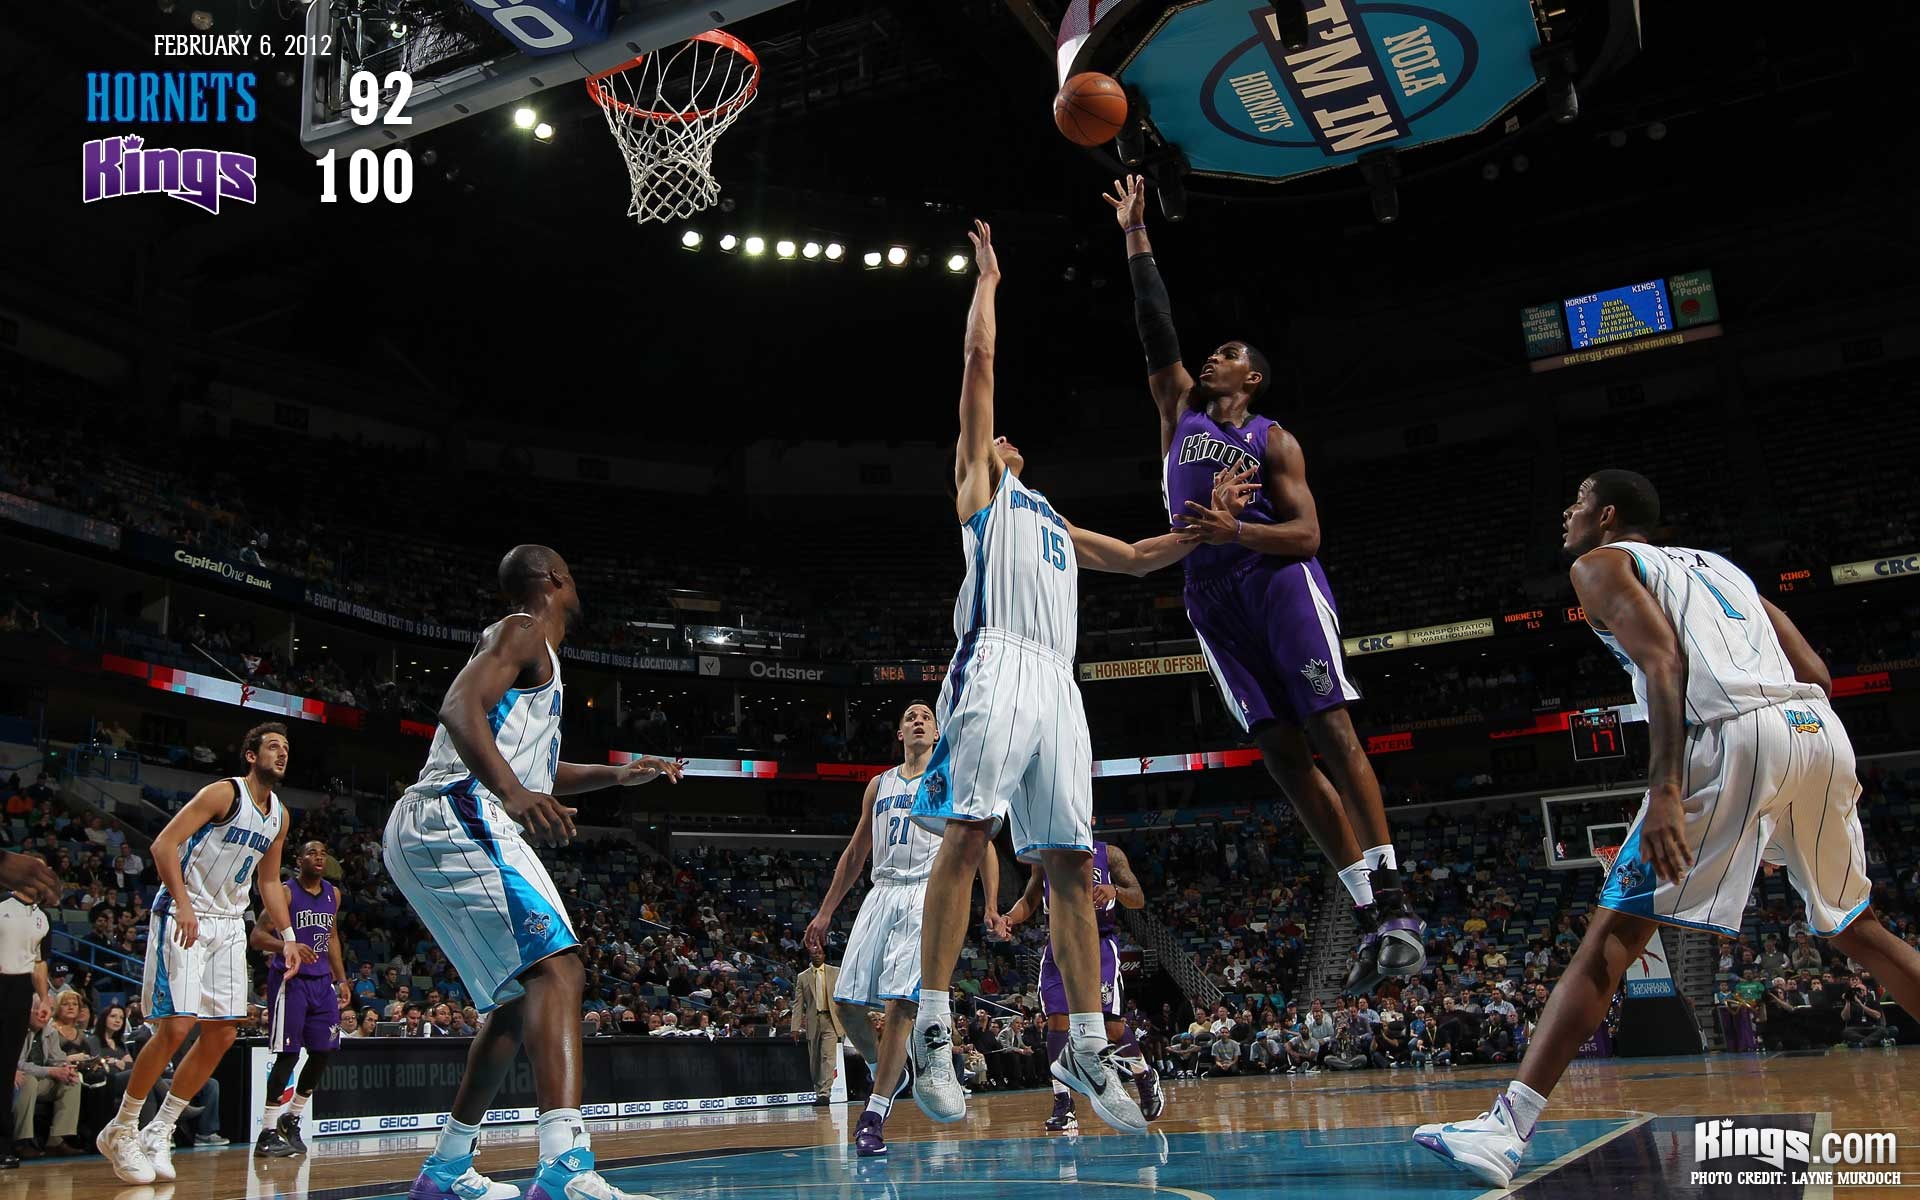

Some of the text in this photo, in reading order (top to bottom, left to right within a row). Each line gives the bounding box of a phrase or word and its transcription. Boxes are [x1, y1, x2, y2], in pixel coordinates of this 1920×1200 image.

[1383, 25, 1447, 97] NOLA
[1228, 70, 1294, 134] HORNETS
[1312, 94, 1400, 152] IN
[1631, 281, 1657, 294] KINGS
[1680, 283, 1712, 297] People
[1565, 294, 1599, 308] HORNETS
[1529, 309, 1556, 321] online
[1537, 321, 1559, 332] save
[1590, 336, 1609, 346] Total
[1609, 331, 1633, 342] Hustle
[1633, 327, 1654, 336] Stats
[1010, 489, 1038, 513] NEW
[1041, 525, 1066, 572] 15
[1780, 569, 1810, 582] KINGS
[1874, 556, 1920, 576] CRC
[245, 573, 273, 591] Bank
[1689, 565, 1747, 621] 1
[314, 592, 337, 611] EVENT
[338, 599, 352, 615] DAY
[352, 604, 388, 625] PROBLEMS
[405, 618, 415, 633] TO
[451, 628, 471, 643] WITH
[1504, 611, 1544, 623] HORNETS
[1411, 622, 1492, 639] TRANSPORTATION
[1420, 629, 1485, 644] WAREHOUSING
[1358, 635, 1394, 652] CRC
[562, 645, 600, 664] FOLLOWED
[601, 652, 611, 666] BY
[640, 657, 679, 671] LOCATION
[749, 659, 824, 682] Ochsner
[880, 666, 905, 681] NBA
[1095, 660, 1161, 679] HORNBECK
[1541, 697, 1561, 707] HUB
[1590, 729, 1617, 754] 17
[876, 796, 895, 818] NEW
[222, 825, 252, 846] NEW
[889, 816, 911, 847] 21
[234, 855, 254, 884] 8
[296, 909, 334, 931] Kings
[1631, 981, 1669, 992] LOUISIANA
[1632, 986, 1671, 997] SEAFOOD
[319, 1118, 360, 1134] GEICO
[379, 1115, 418, 1130] GEICO
[486, 1109, 520, 1123] GEICO
[581, 1104, 610, 1117] GEICO
[624, 1102, 651, 1114] GEICO
[663, 1100, 689, 1112] GEICO
[700, 1098, 725, 1110] GEICO
[734, 1096, 757, 1106] GEICO
[766, 1094, 789, 1105] GEICO
